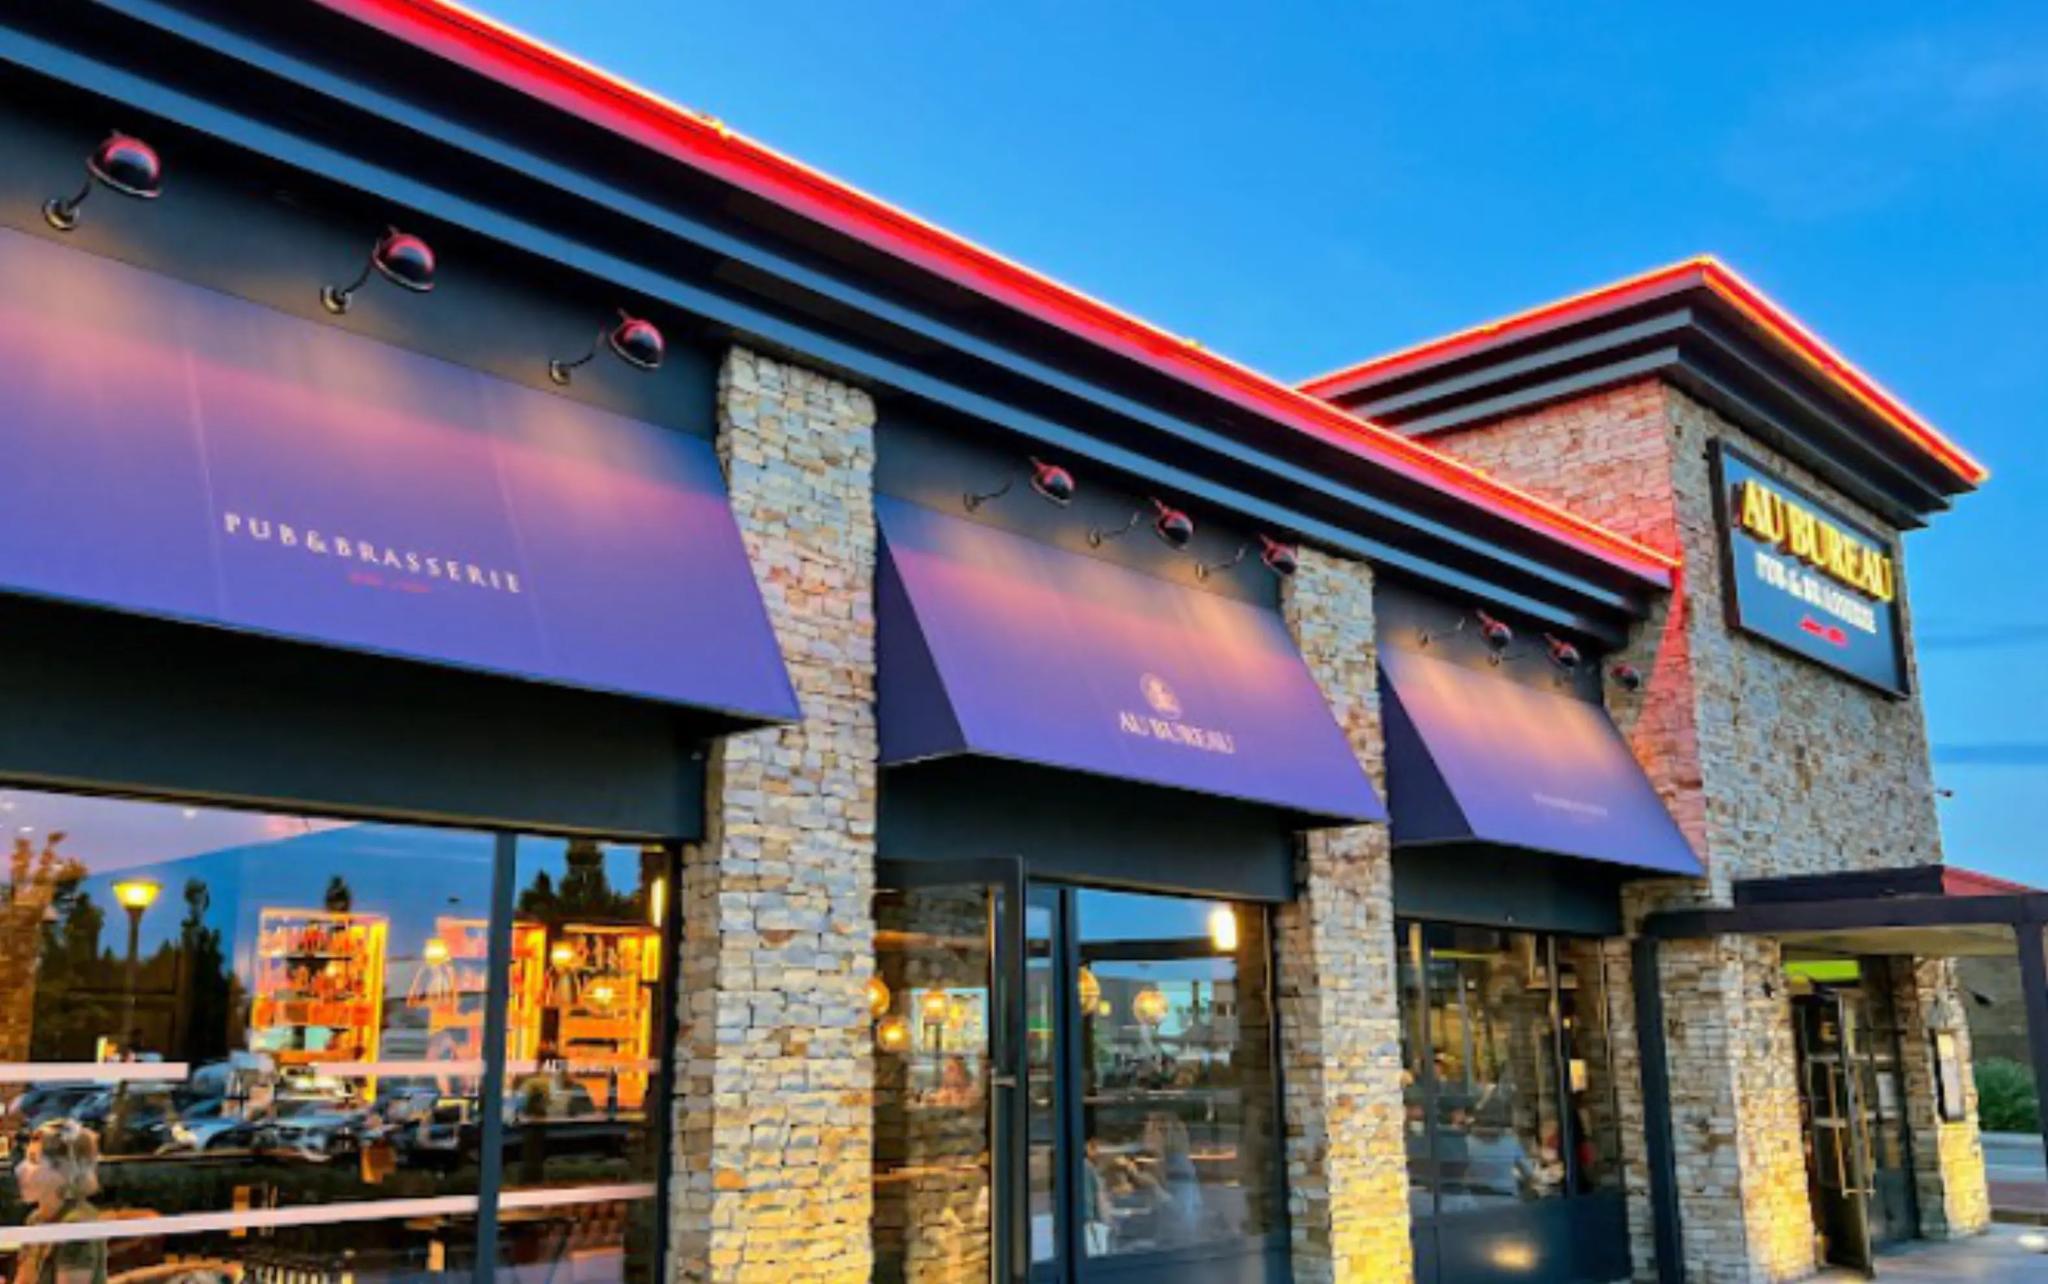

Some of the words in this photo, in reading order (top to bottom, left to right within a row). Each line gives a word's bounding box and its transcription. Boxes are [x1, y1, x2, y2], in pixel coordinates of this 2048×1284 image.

[1742, 480, 1784, 542] AU
[1788, 502, 1893, 602] BUREAU
[1119, 711, 1149, 736] AU
